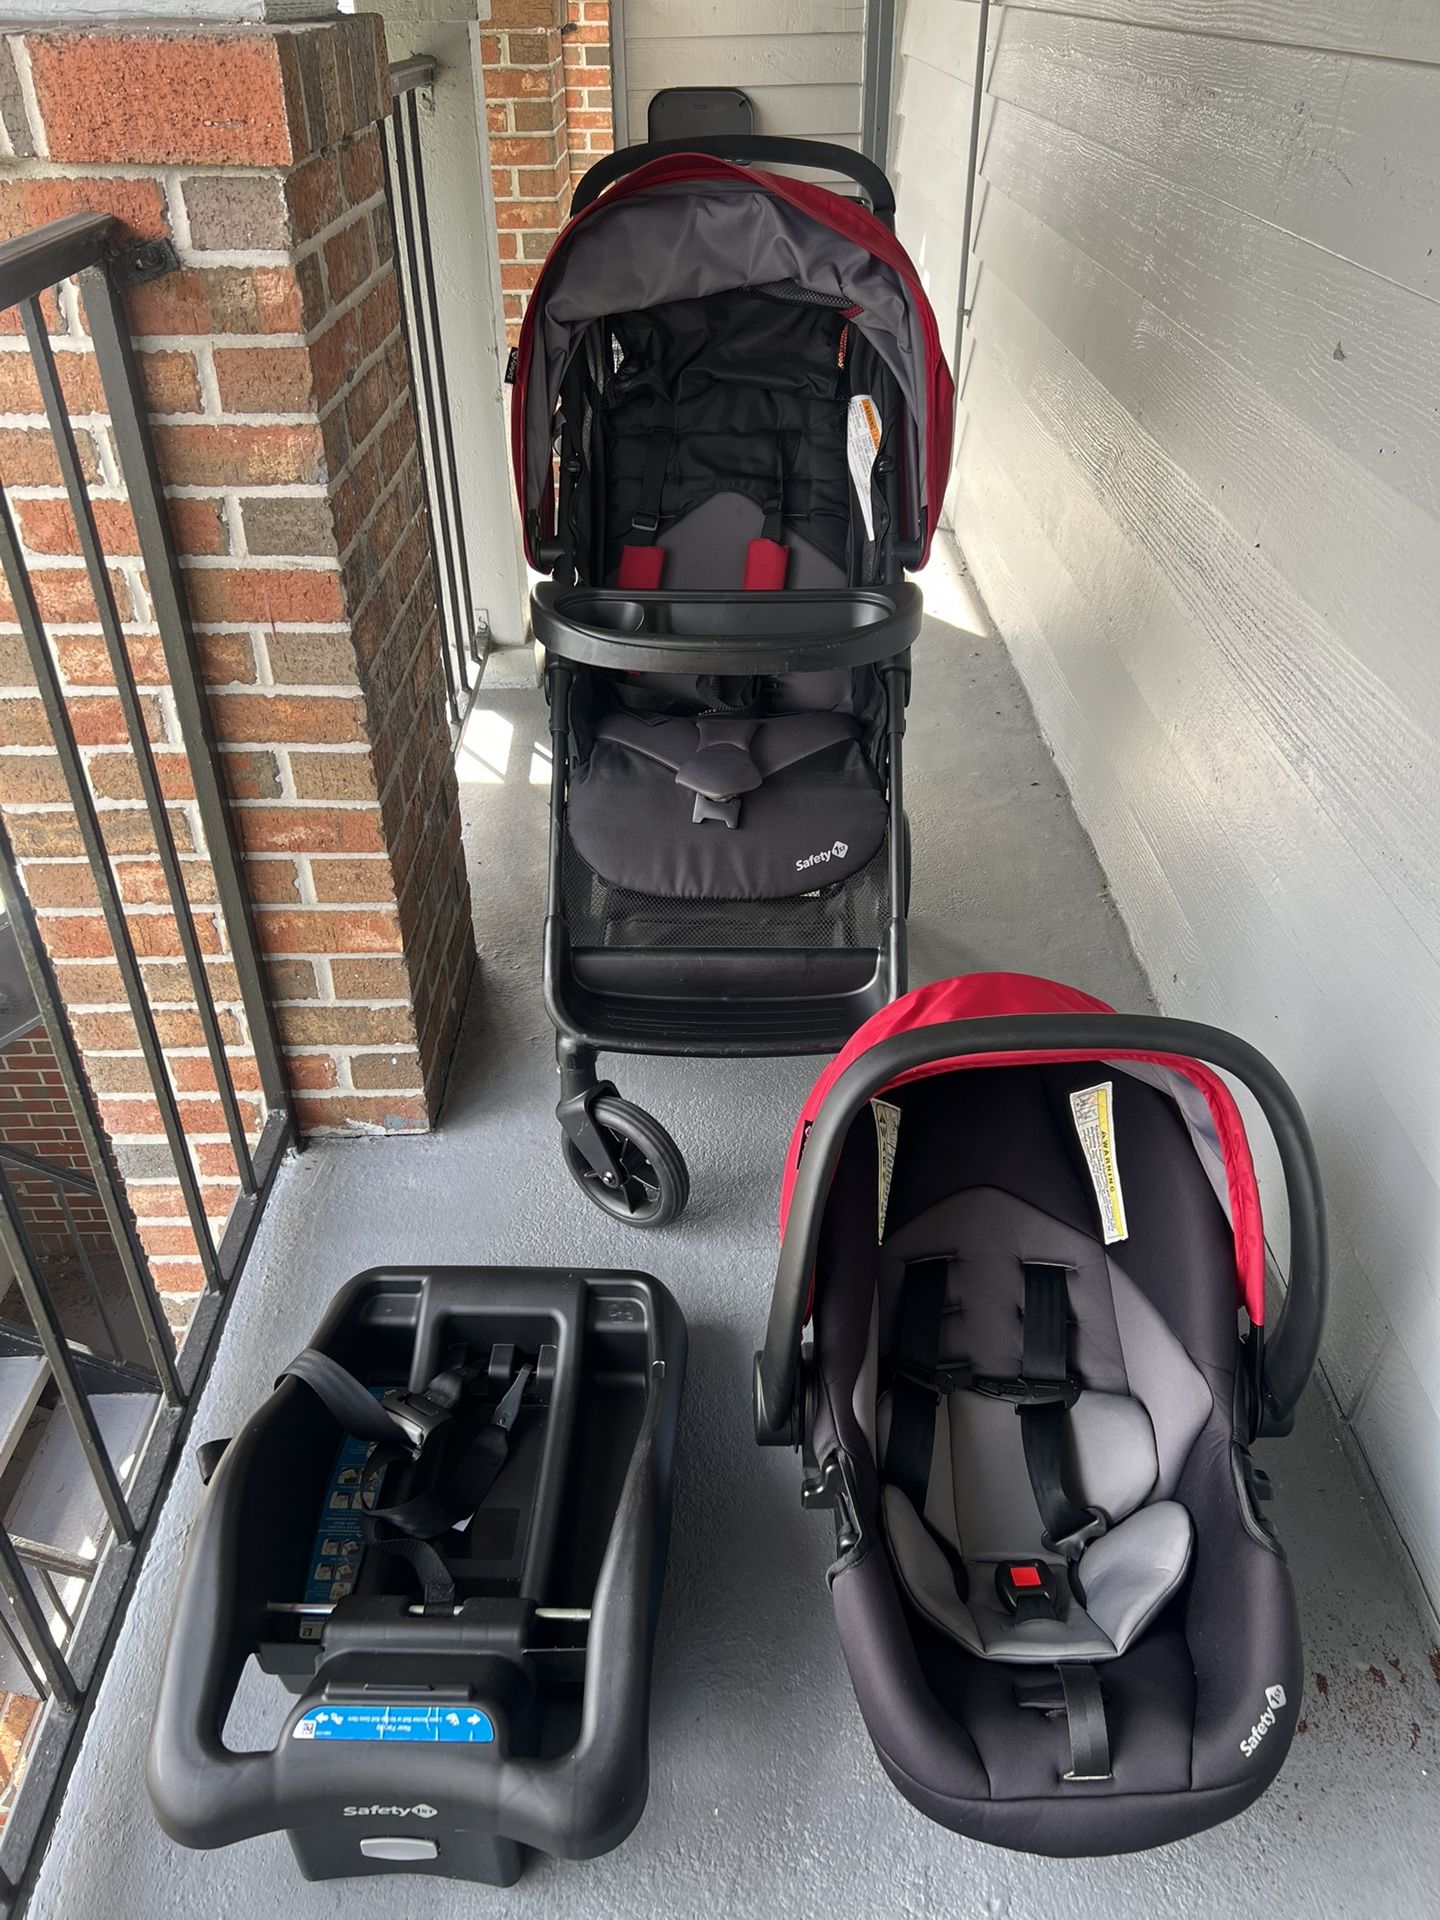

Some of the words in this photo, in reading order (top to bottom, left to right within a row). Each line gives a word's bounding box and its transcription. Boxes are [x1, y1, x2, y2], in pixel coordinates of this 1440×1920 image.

[795, 850, 831, 871] Safety
[1102, 1140, 1115, 1192] WARNING
[1240, 1706, 1276, 1758] Safety
[343, 1805, 411, 1817] Safety
